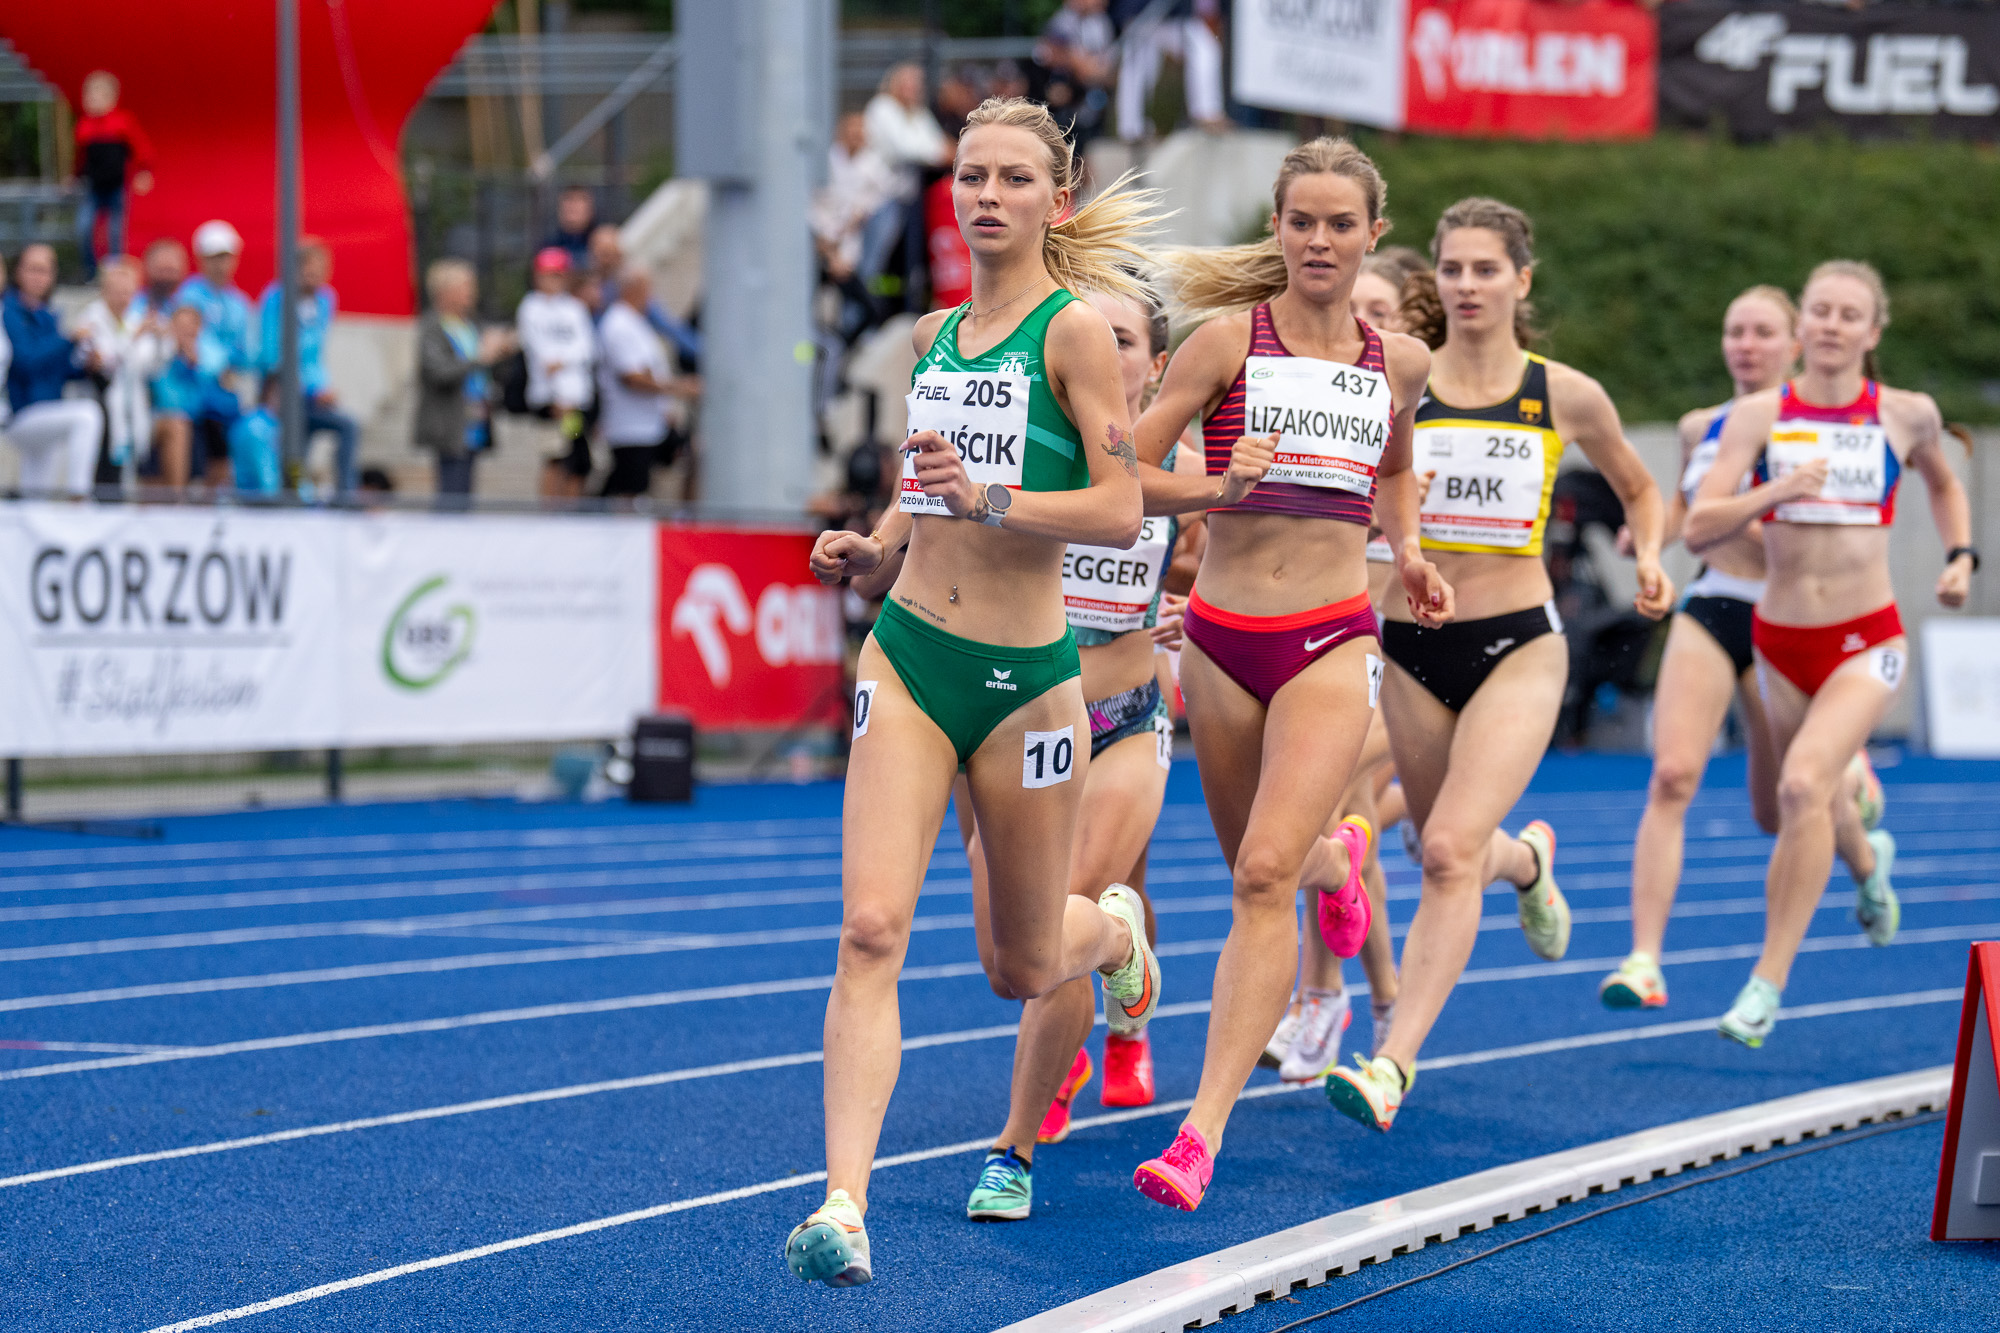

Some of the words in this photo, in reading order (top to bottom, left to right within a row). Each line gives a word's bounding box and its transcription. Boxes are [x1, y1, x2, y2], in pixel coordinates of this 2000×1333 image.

[1452, 31, 1626, 96] ORLEN
[1768, 33, 1998, 117] FUEL
[916, 385, 951, 401] FUEL
[963, 379, 1012, 408] 205
[1331, 370, 1378, 398] 437
[1251, 406, 1383, 449] LIZAKOWSKA
[1834, 432, 1874, 451] 507
[1485, 437, 1532, 459] 256
[1277, 454, 1299, 464] PZLA
[1299, 456, 1349, 469] Mistrzostwa
[1349, 462, 1369, 474] Polski
[1446, 477, 1503, 508] BĄK
[32, 527, 291, 626] GORZÓW
[1881, 654, 1898, 682] 8
[985, 680, 1017, 691] erima
[1026, 737, 1072, 779] 10
